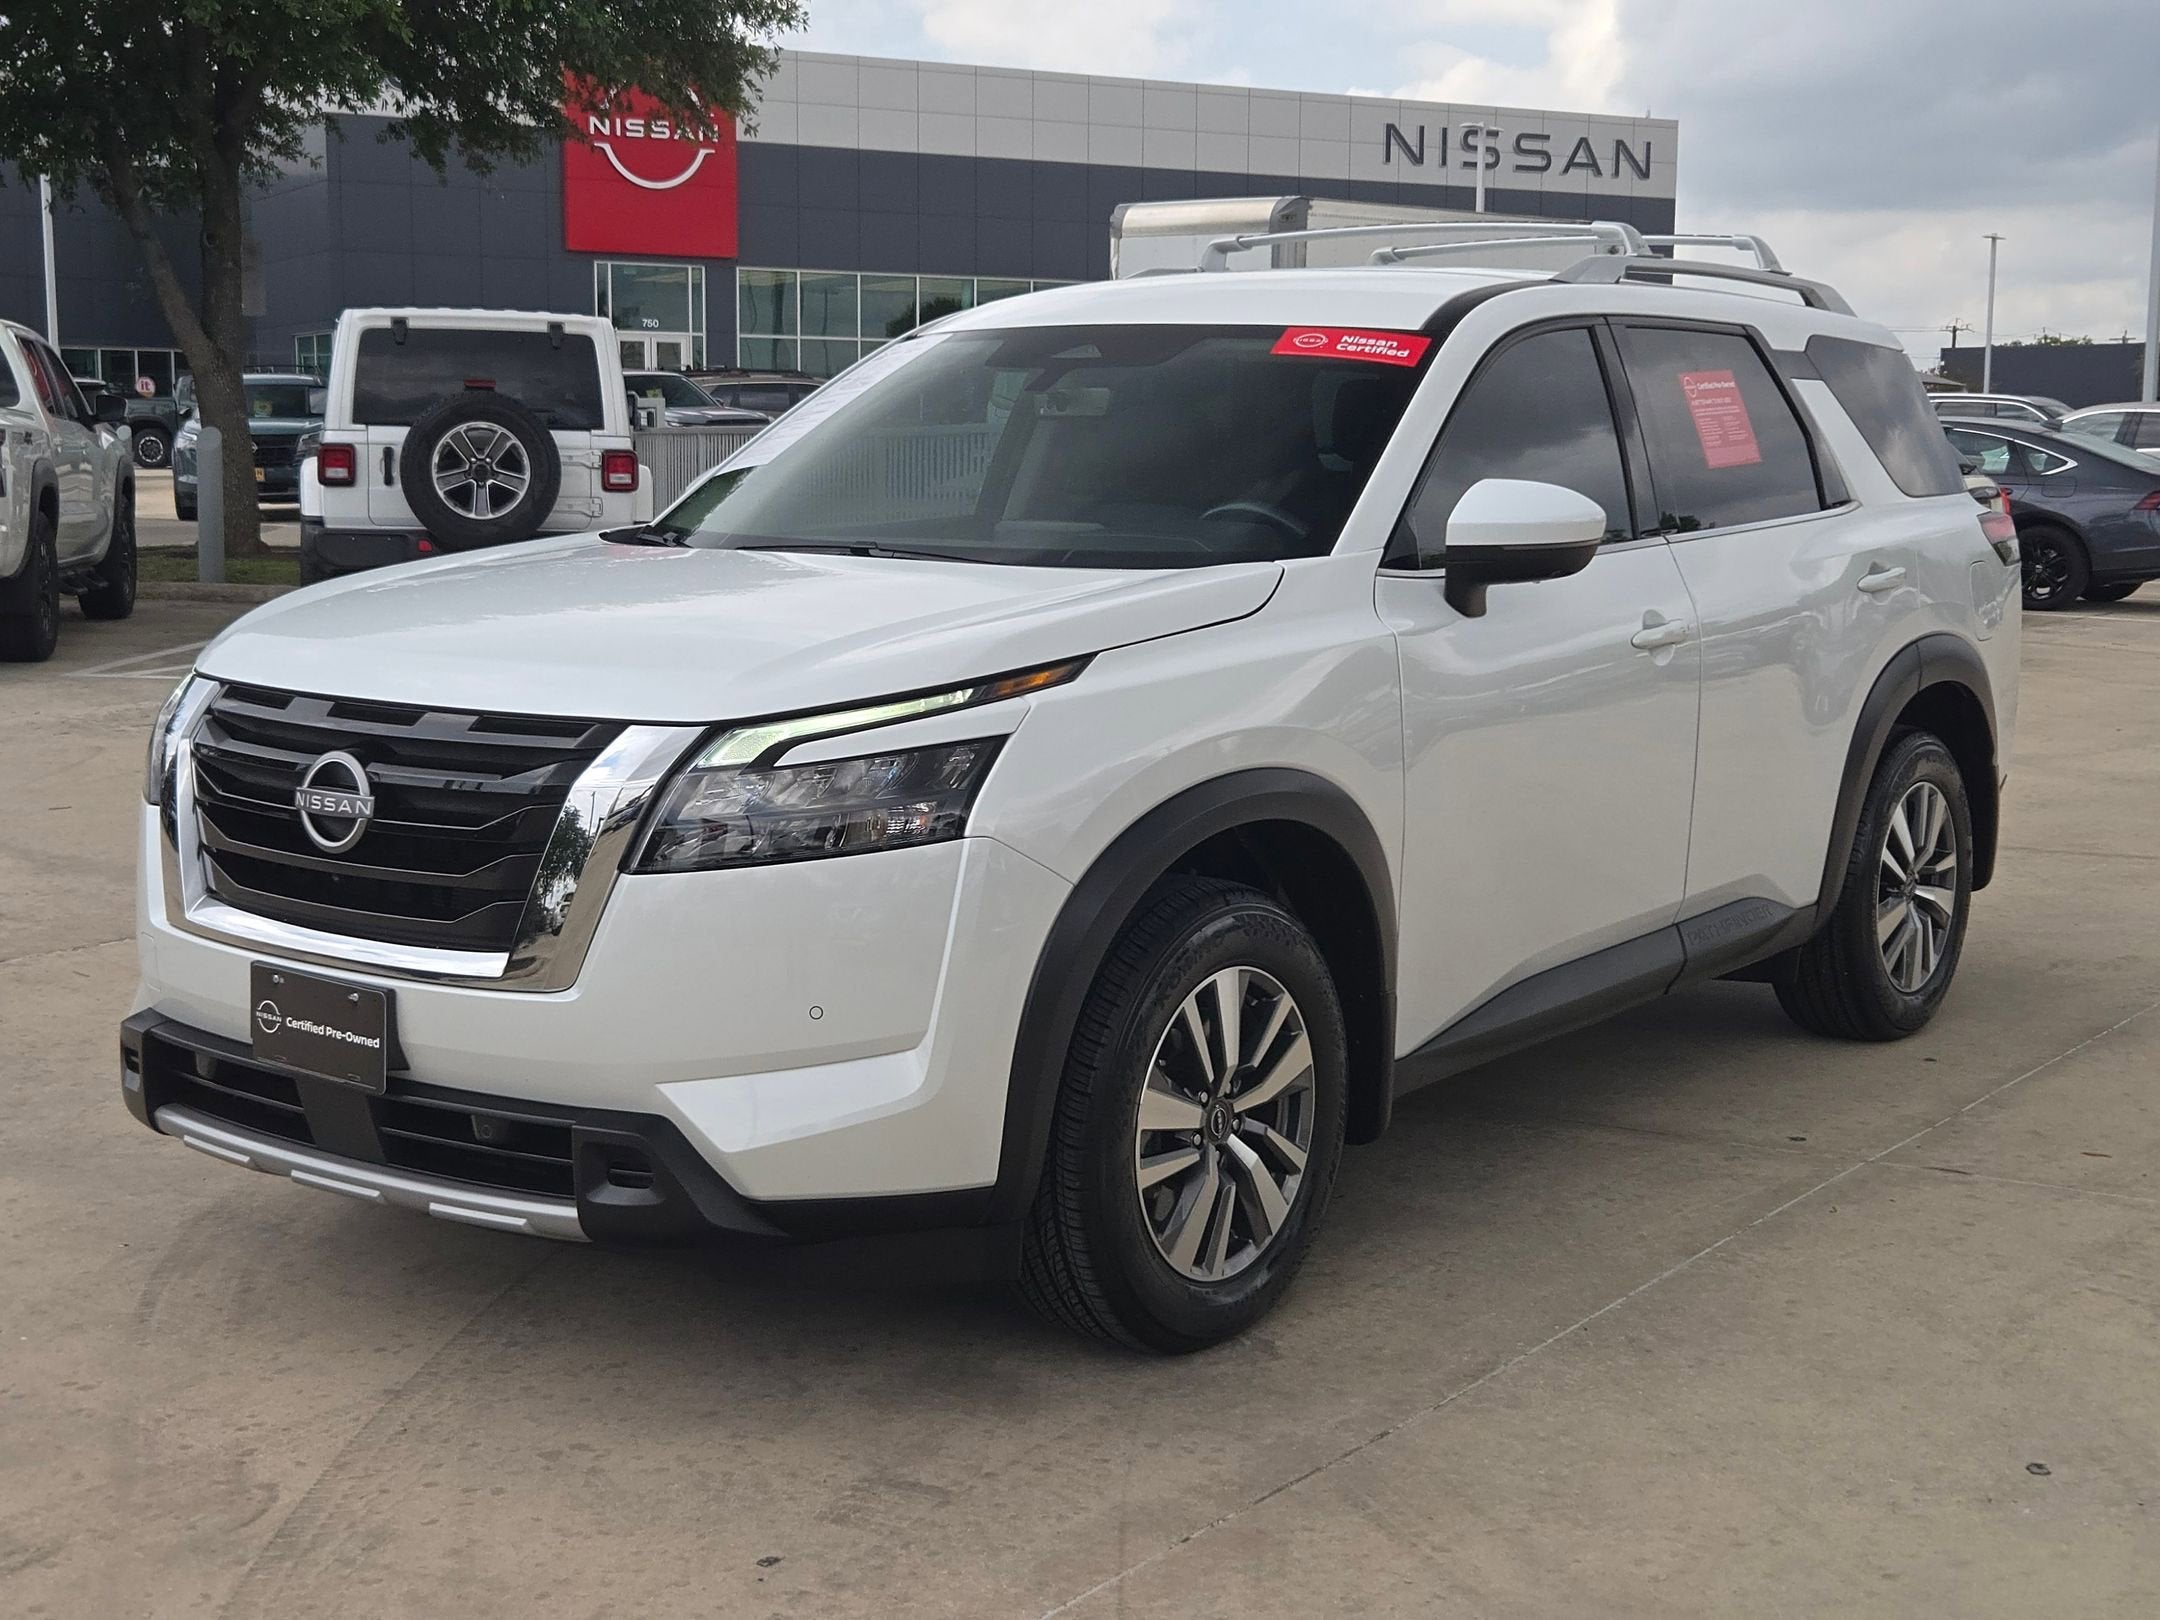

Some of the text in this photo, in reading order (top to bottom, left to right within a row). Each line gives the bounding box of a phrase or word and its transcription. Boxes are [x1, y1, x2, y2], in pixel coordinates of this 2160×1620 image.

[1383, 123, 1652, 181] NISSAN
[642, 319, 660, 329] 750
[1341, 335, 1398, 348] Nissan
[1336, 343, 1410, 358] Certified
[296, 791, 371, 814] NISSAN
[256, 1010, 282, 1023] NISSAN
[286, 1016, 380, 1049] Certified Pre-Owned
